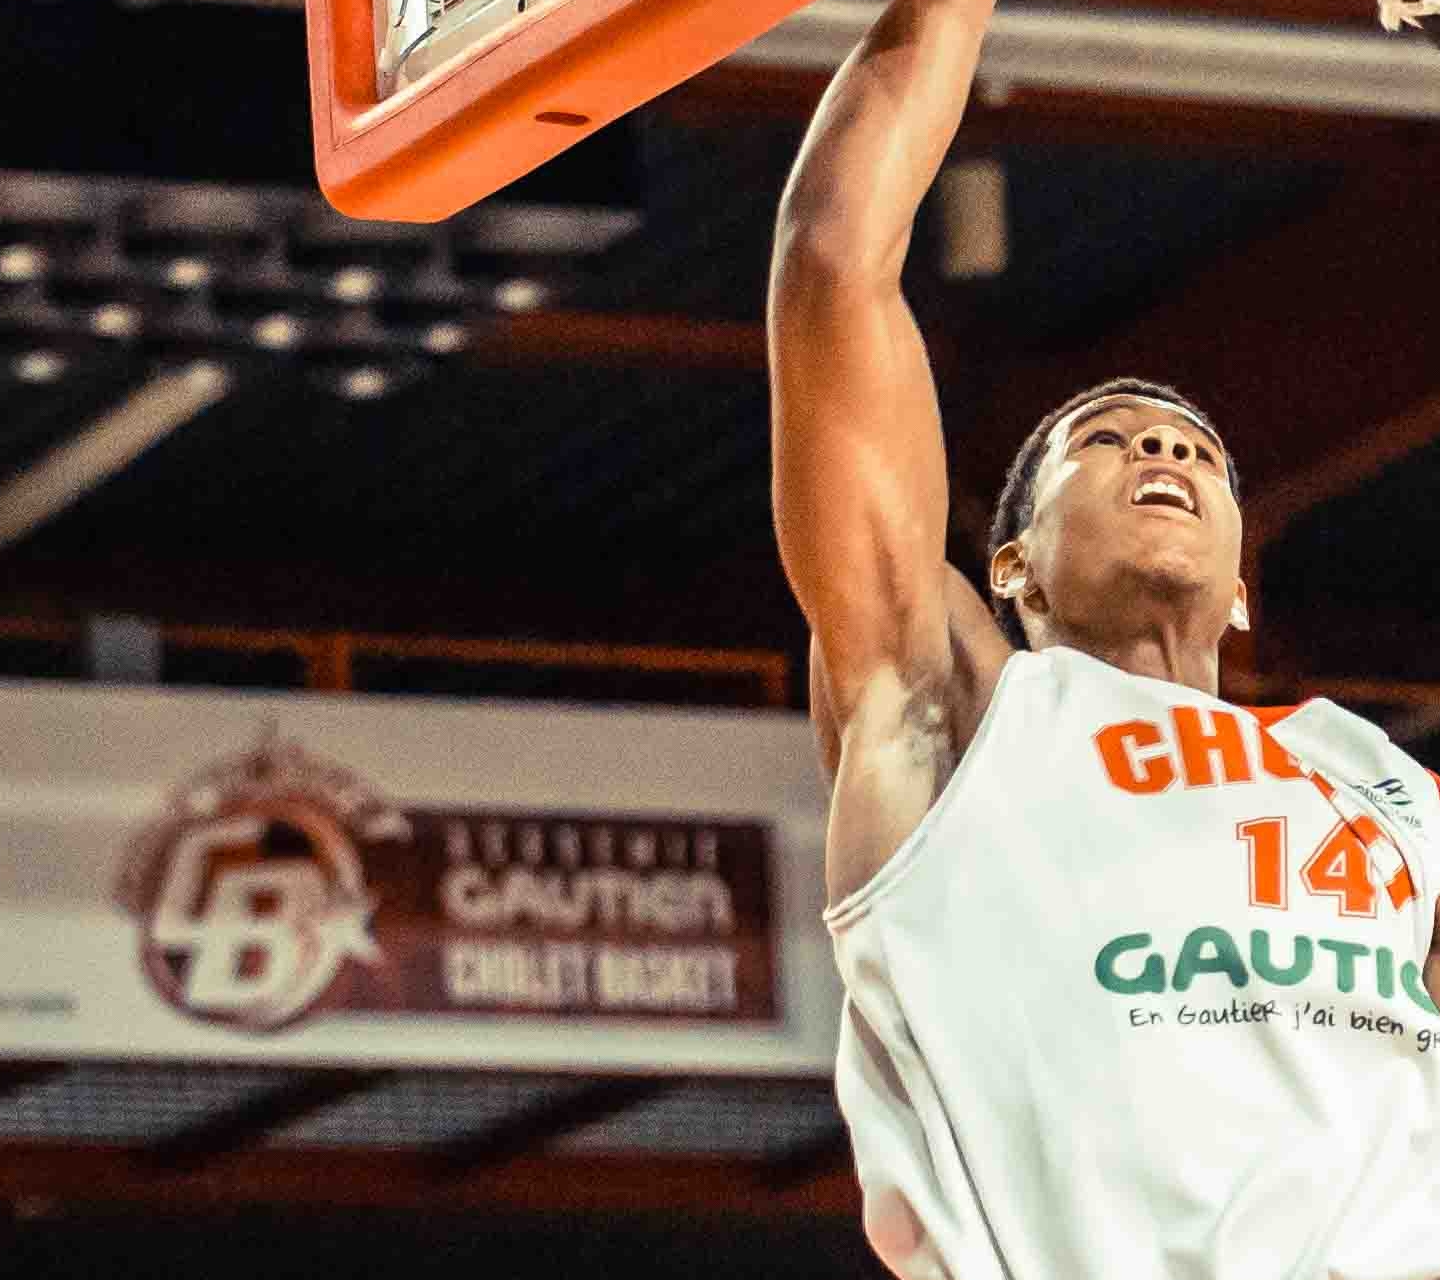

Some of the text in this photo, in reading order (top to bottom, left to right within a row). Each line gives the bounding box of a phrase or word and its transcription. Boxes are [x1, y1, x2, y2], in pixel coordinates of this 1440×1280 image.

[1236, 816, 1418, 919] 14
[1128, 1006, 1163, 1028] En
[1294, 1001, 1336, 1031] j'ai
[1350, 1005, 1405, 1038] bien
